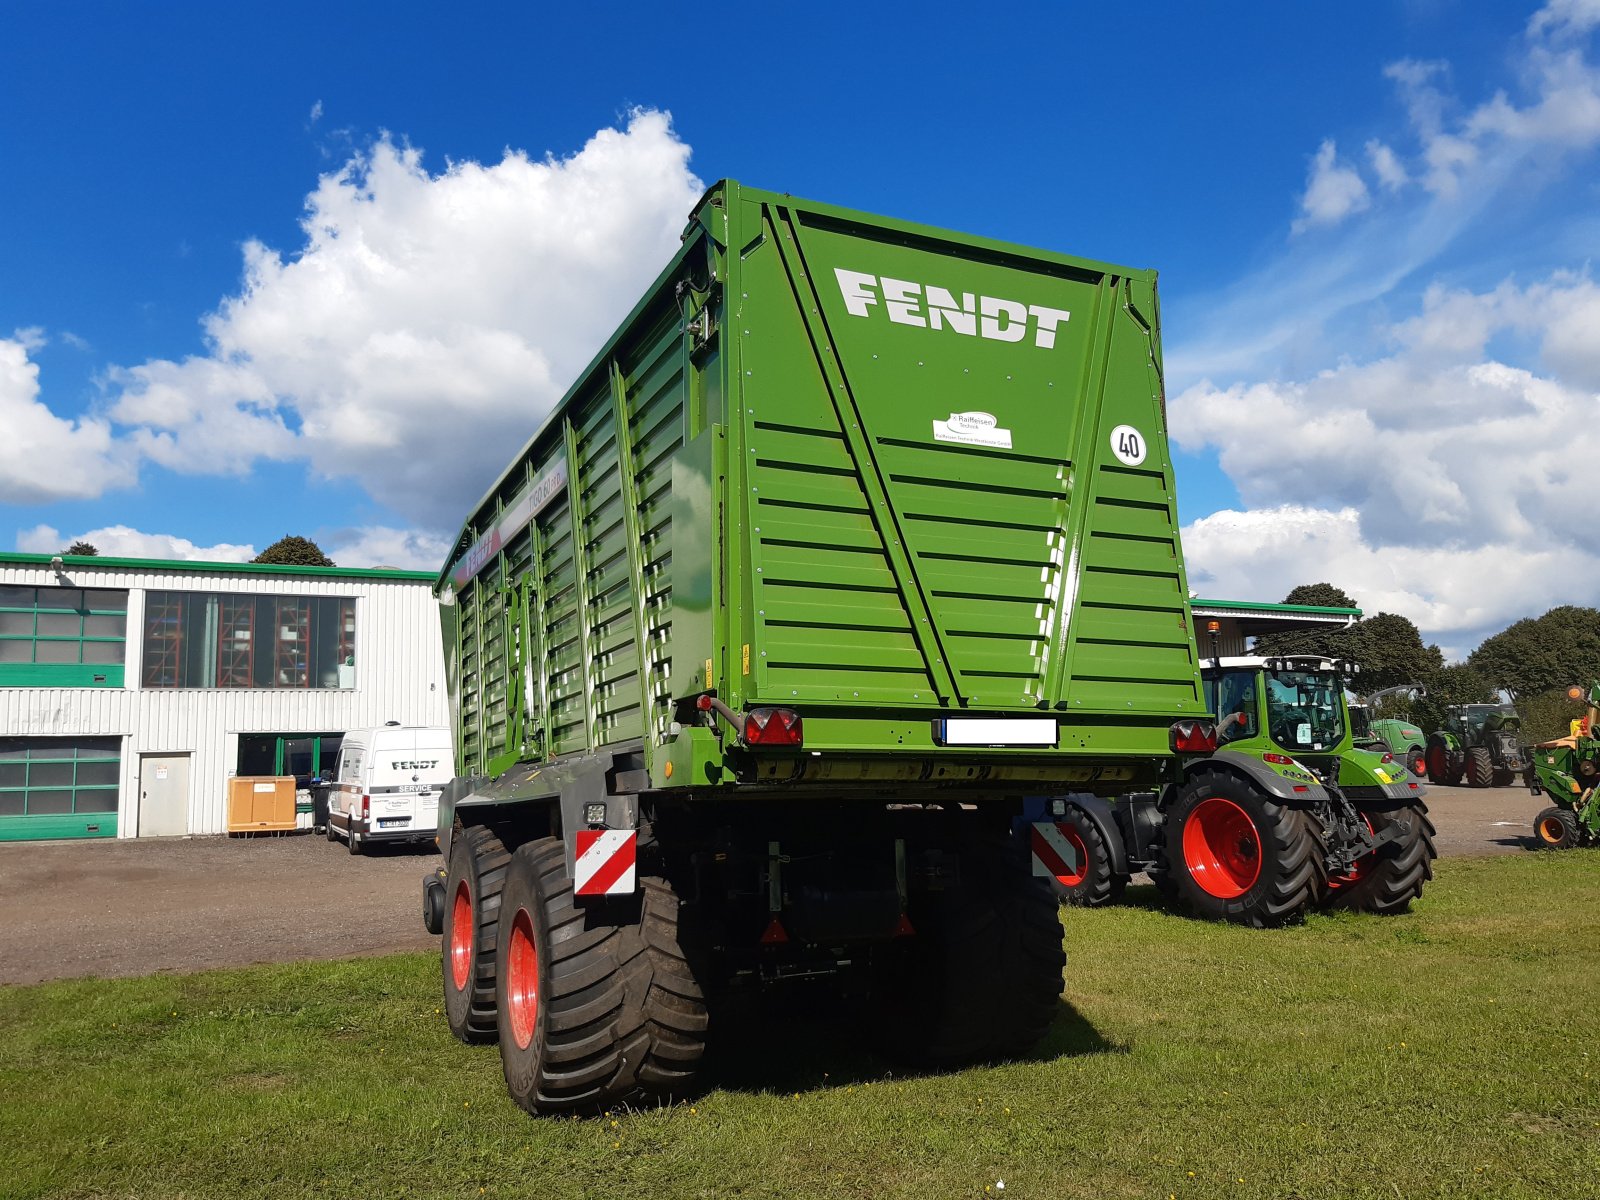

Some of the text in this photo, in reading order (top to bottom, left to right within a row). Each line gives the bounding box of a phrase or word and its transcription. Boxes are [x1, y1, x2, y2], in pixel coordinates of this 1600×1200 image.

[833, 267, 1071, 349] FENDT
[958, 415, 993, 426] Raiffeisen
[1118, 432, 1140, 459] 40
[392, 760, 439, 770] FENDT
[399, 784, 432, 792] SERVICE
